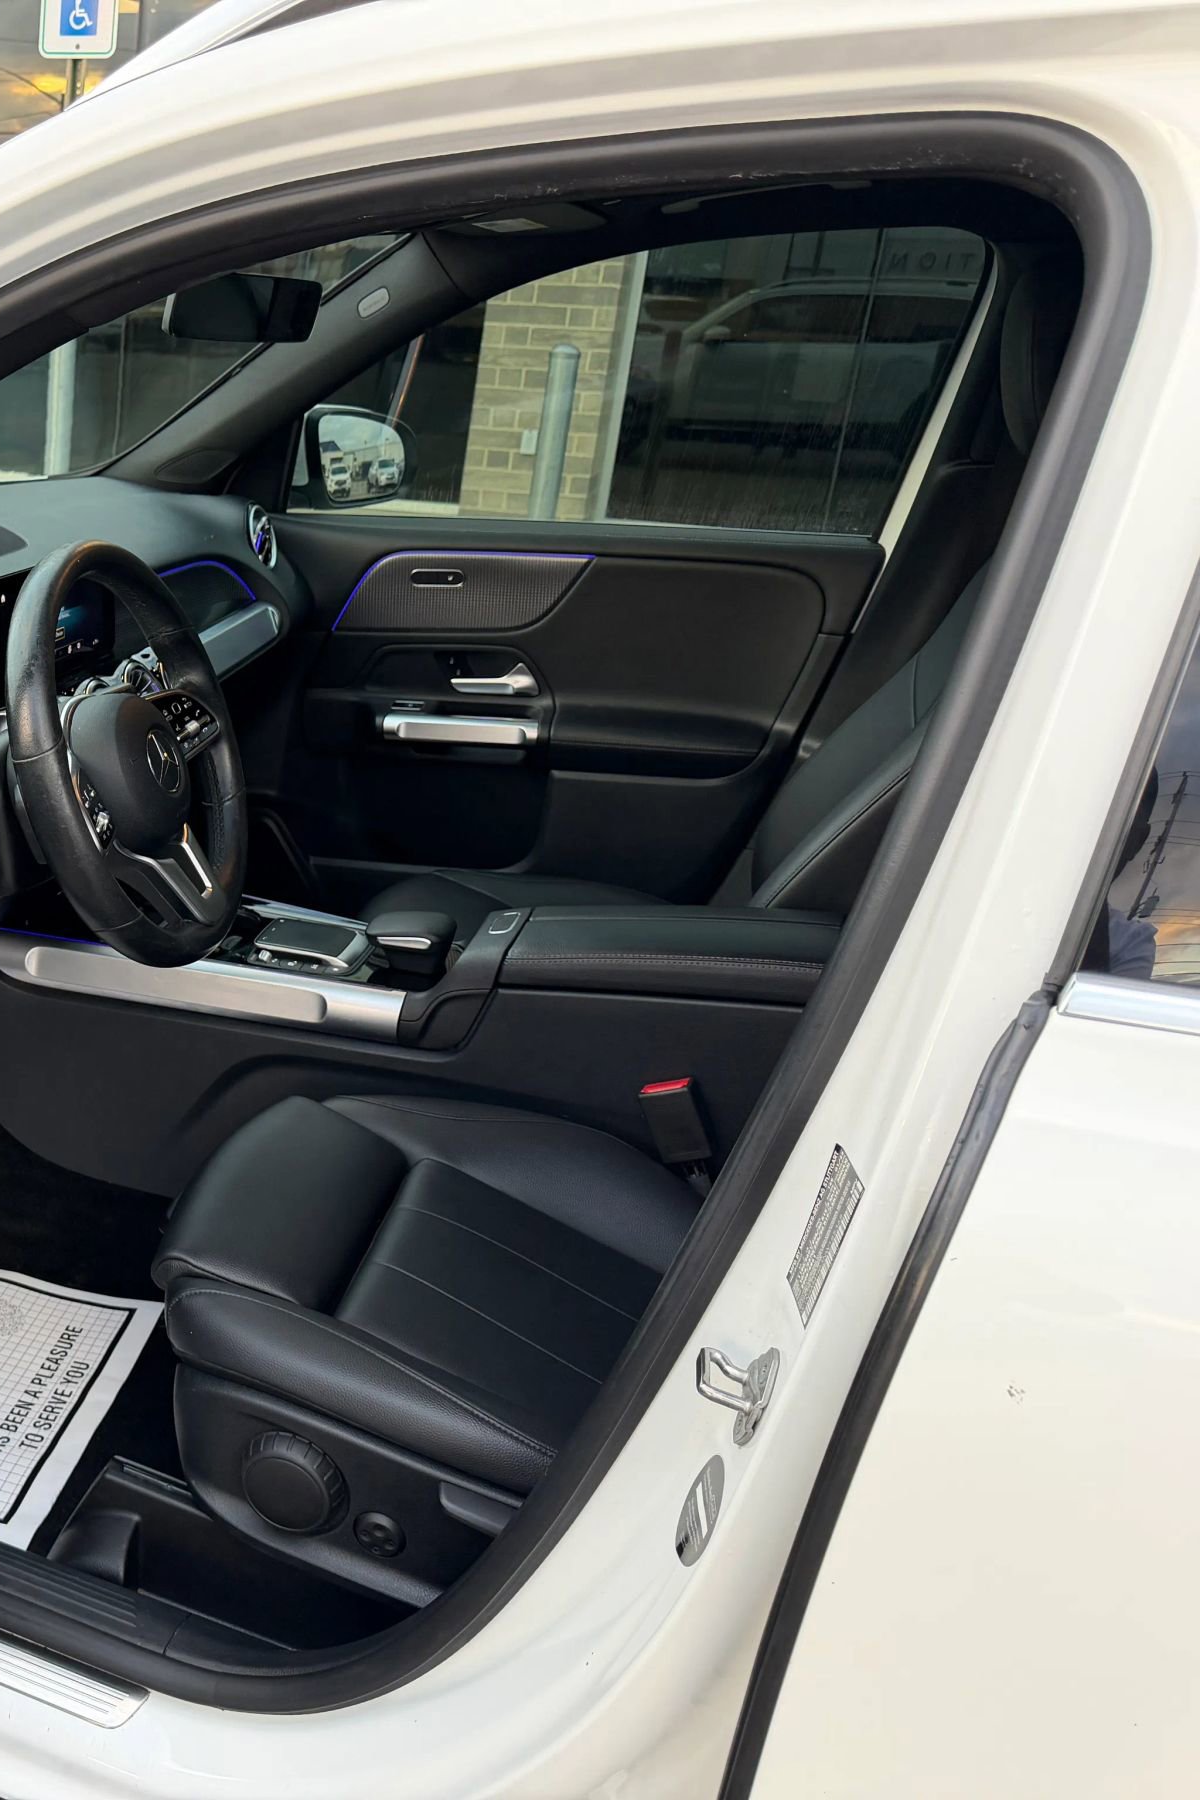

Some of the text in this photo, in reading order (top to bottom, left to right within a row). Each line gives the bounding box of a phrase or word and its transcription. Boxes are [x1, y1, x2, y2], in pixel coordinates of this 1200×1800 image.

[822, 1149, 840, 1189] STUTTGART
[31, 1324, 83, 1387] PLEASURE
[19, 1360, 90, 1450] TO SERVE YOU
[23, 1388, 43, 1400] A
[0, 1400, 35, 1433] BEEN
